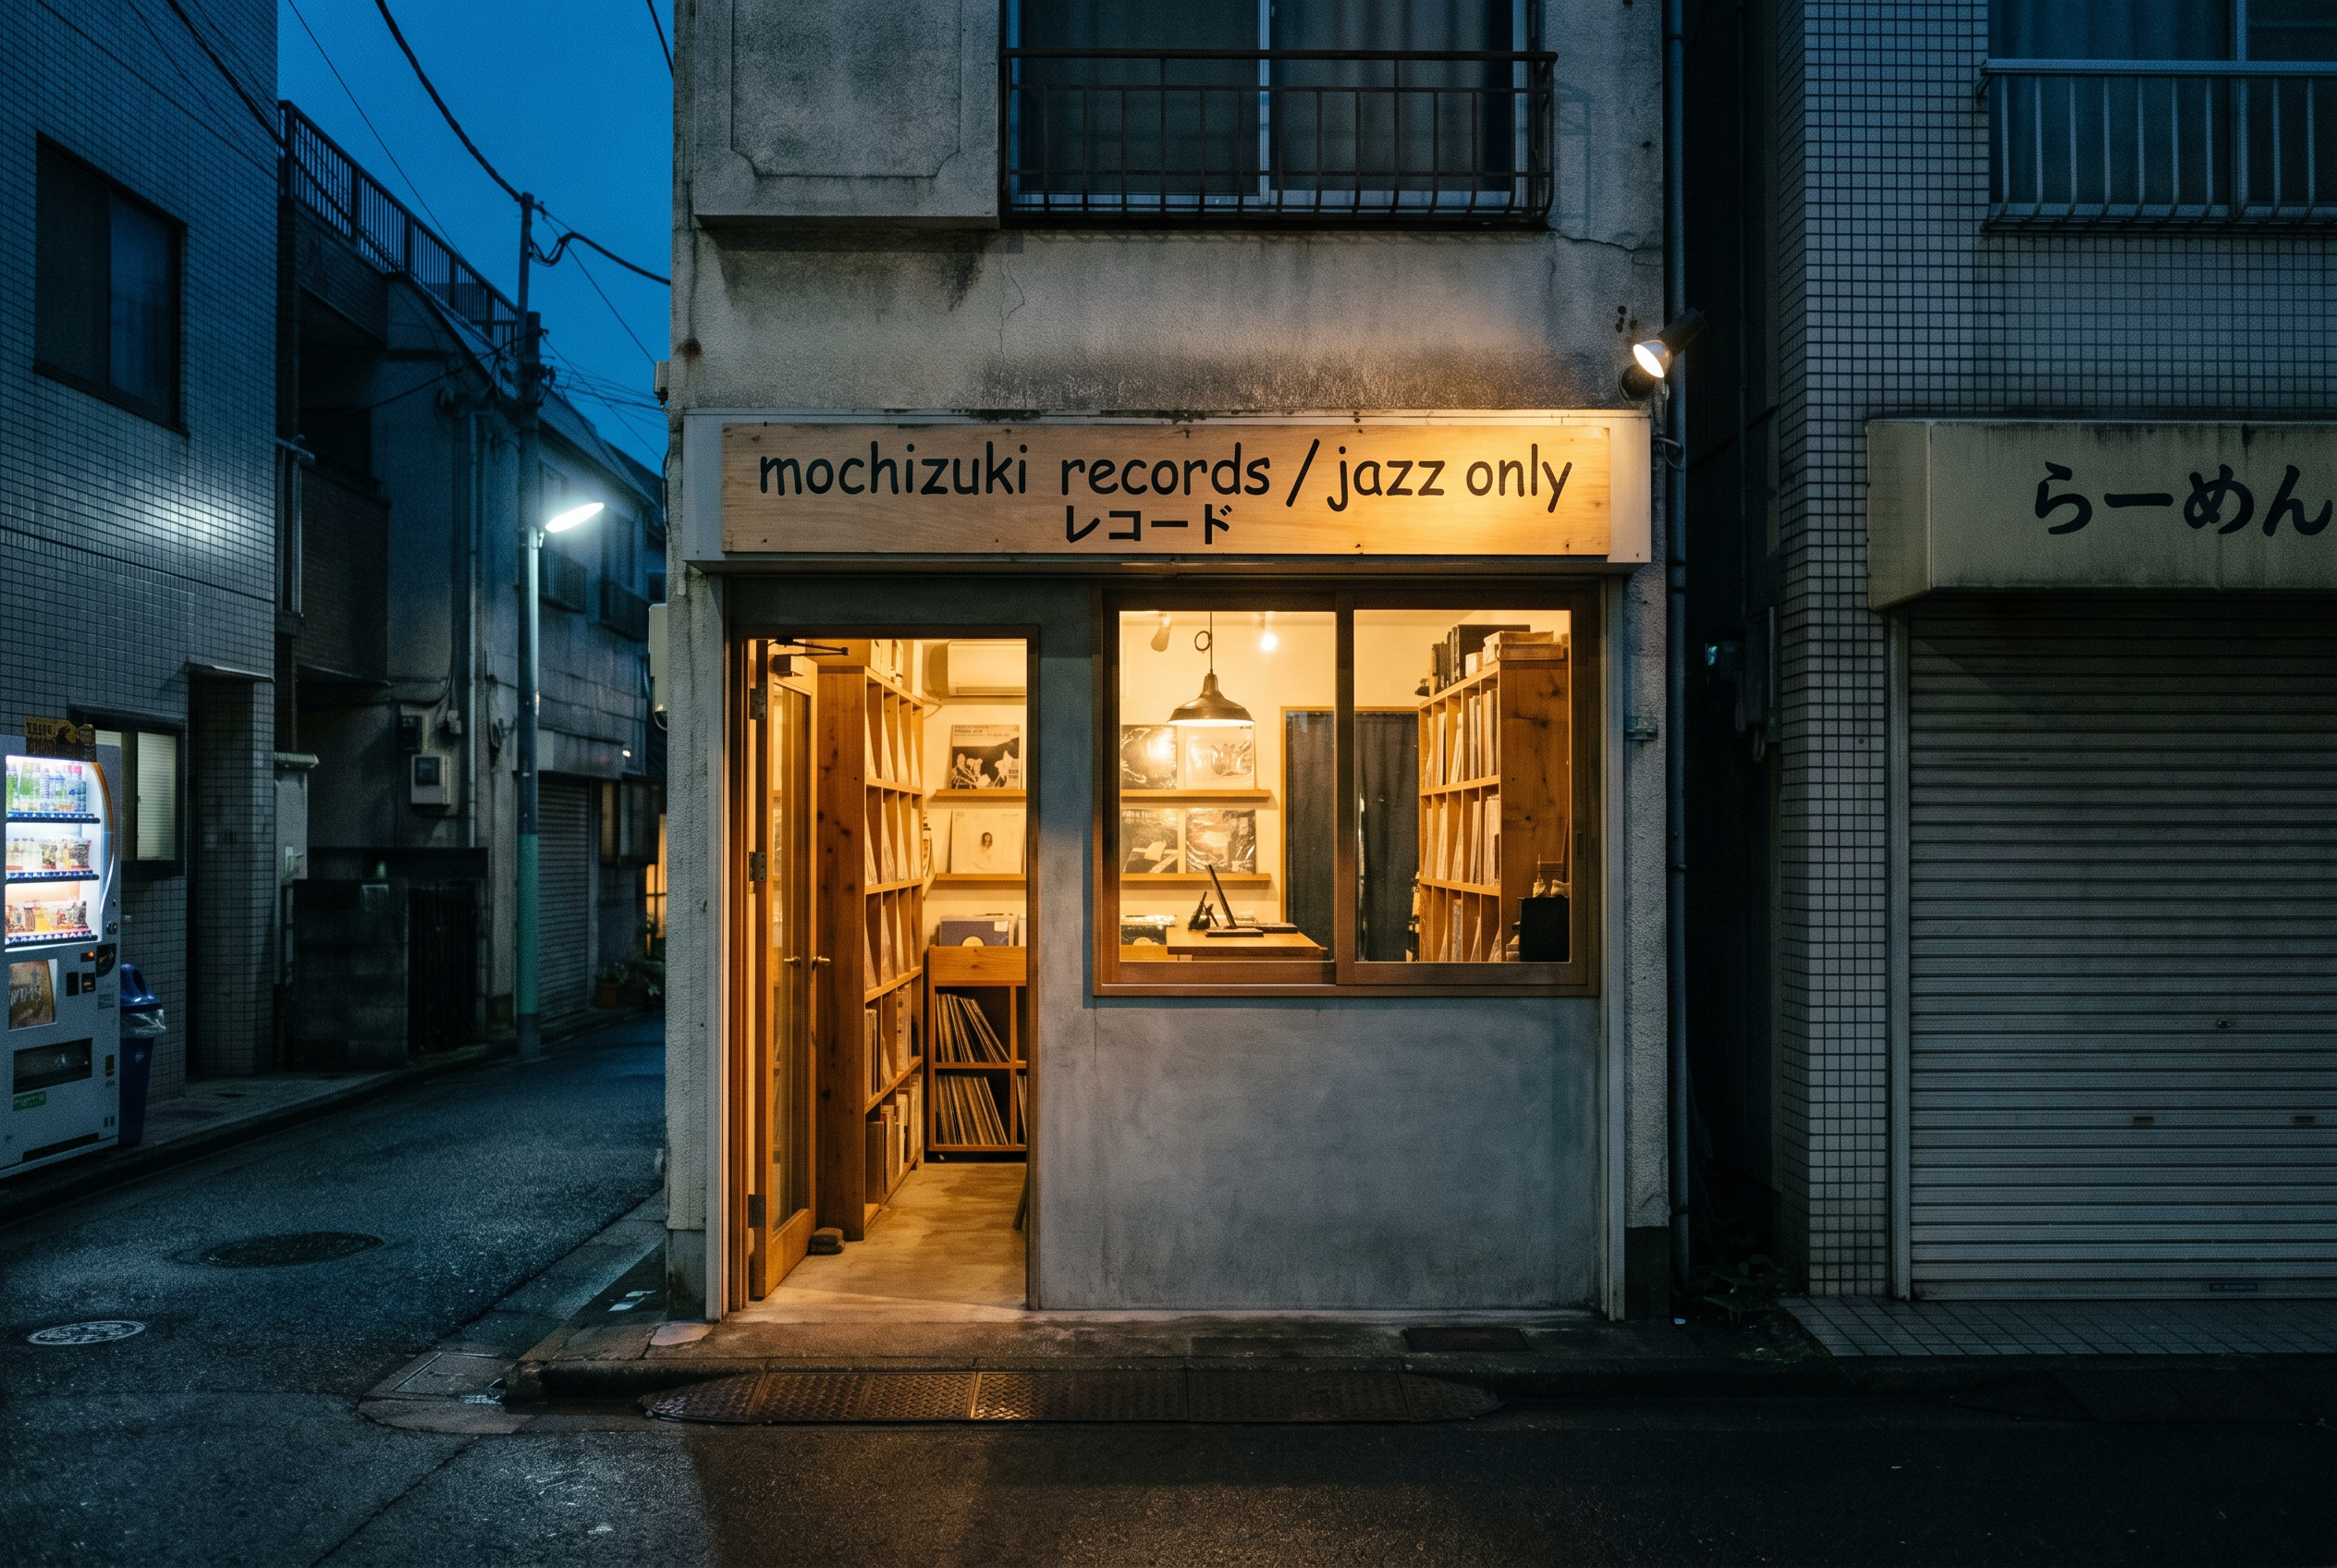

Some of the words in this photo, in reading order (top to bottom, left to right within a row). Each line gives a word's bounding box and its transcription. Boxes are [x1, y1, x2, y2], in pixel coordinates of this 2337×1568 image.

[760, 440, 1028, 496] mochizuki
[1061, 441, 1271, 496] records
[1327, 446, 1446, 512] jazz
[1465, 443, 1572, 514] only
[2034, 460, 2333, 538] らーめん
[1065, 503, 1231, 545] レコード
